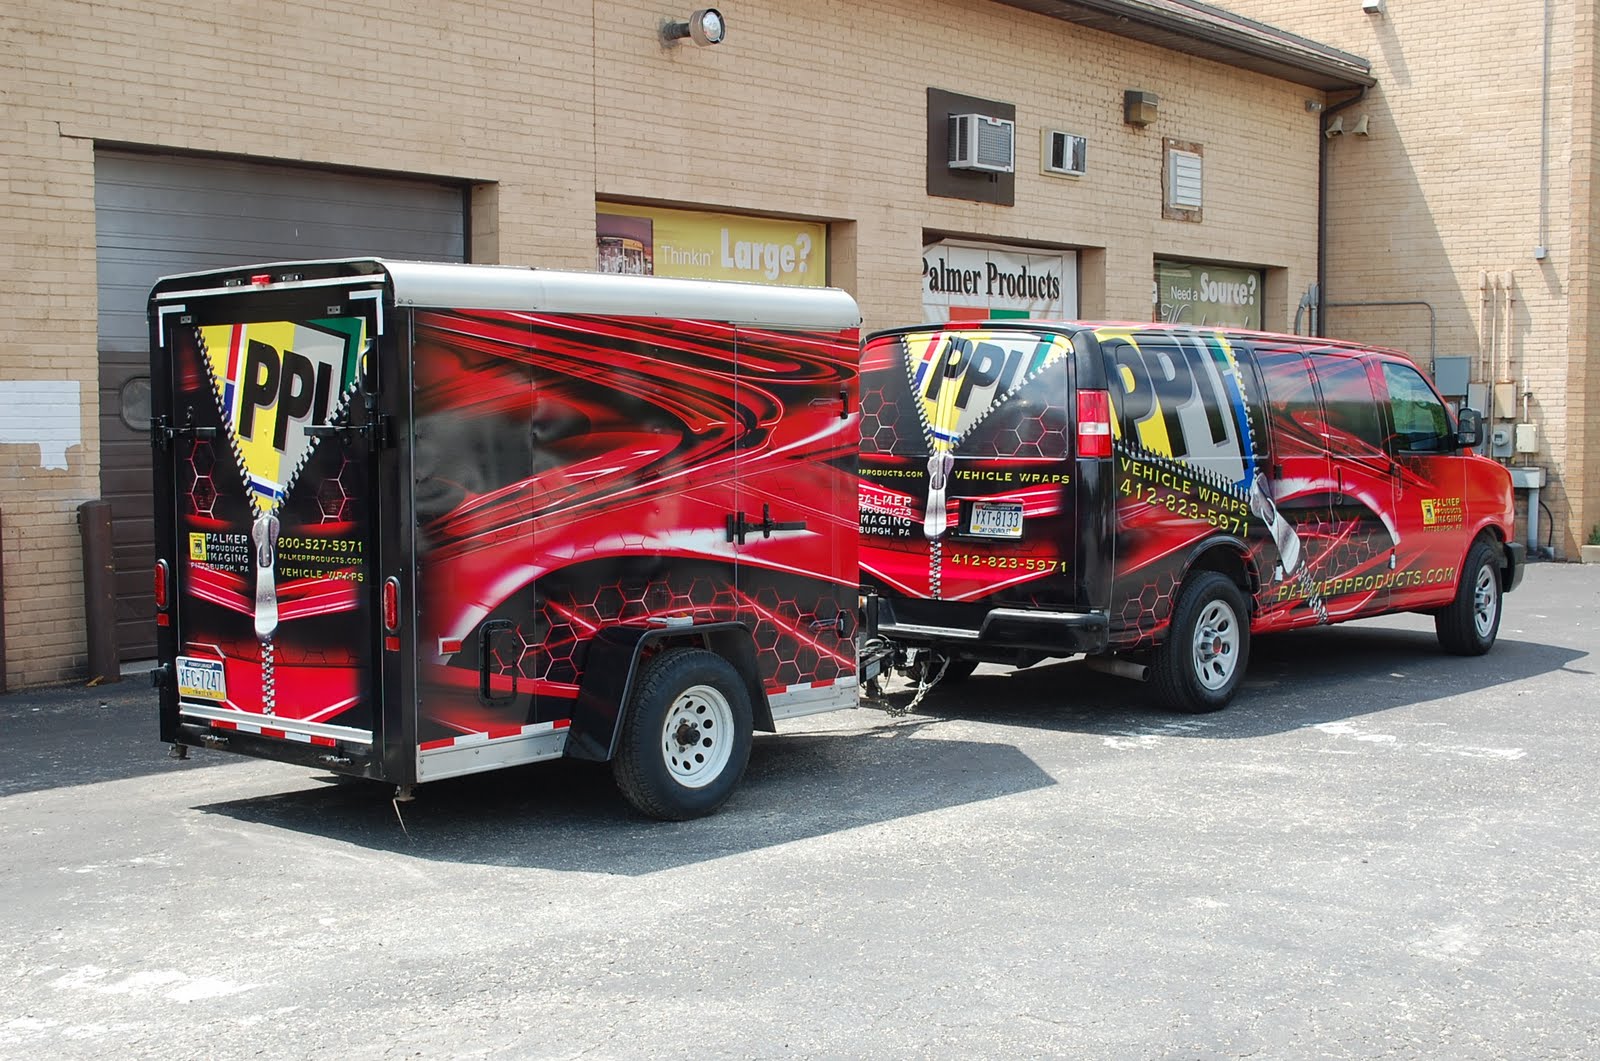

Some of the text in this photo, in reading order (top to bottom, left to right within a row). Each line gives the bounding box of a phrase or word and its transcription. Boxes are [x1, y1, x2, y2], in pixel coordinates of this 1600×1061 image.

[661, 228, 812, 280] Thinkin' Large?
[985, 261, 1060, 300] Products
[1170, 285, 1191, 301] Need
[1192, 290, 1198, 301] a
[1200, 272, 1257, 305] Source?
[925, 335, 1024, 410] PPI
[238, 338, 333, 456] PPI
[1098, 336, 1231, 459] PPI
[955, 470, 1070, 484] VEHICLE WRAPS
[1120, 457, 1248, 517] VEHICLE WRAPS
[1119, 478, 1249, 538] 412-823-5971
[206, 533, 248, 544] PALMER
[278, 537, 362, 553] 800-527-5971
[898, 528, 911, 536] PA
[207, 552, 249, 563] IMAGING
[951, 553, 1067, 573] 412-823-5971
[280, 567, 364, 582] VEHICLE WRAPS
